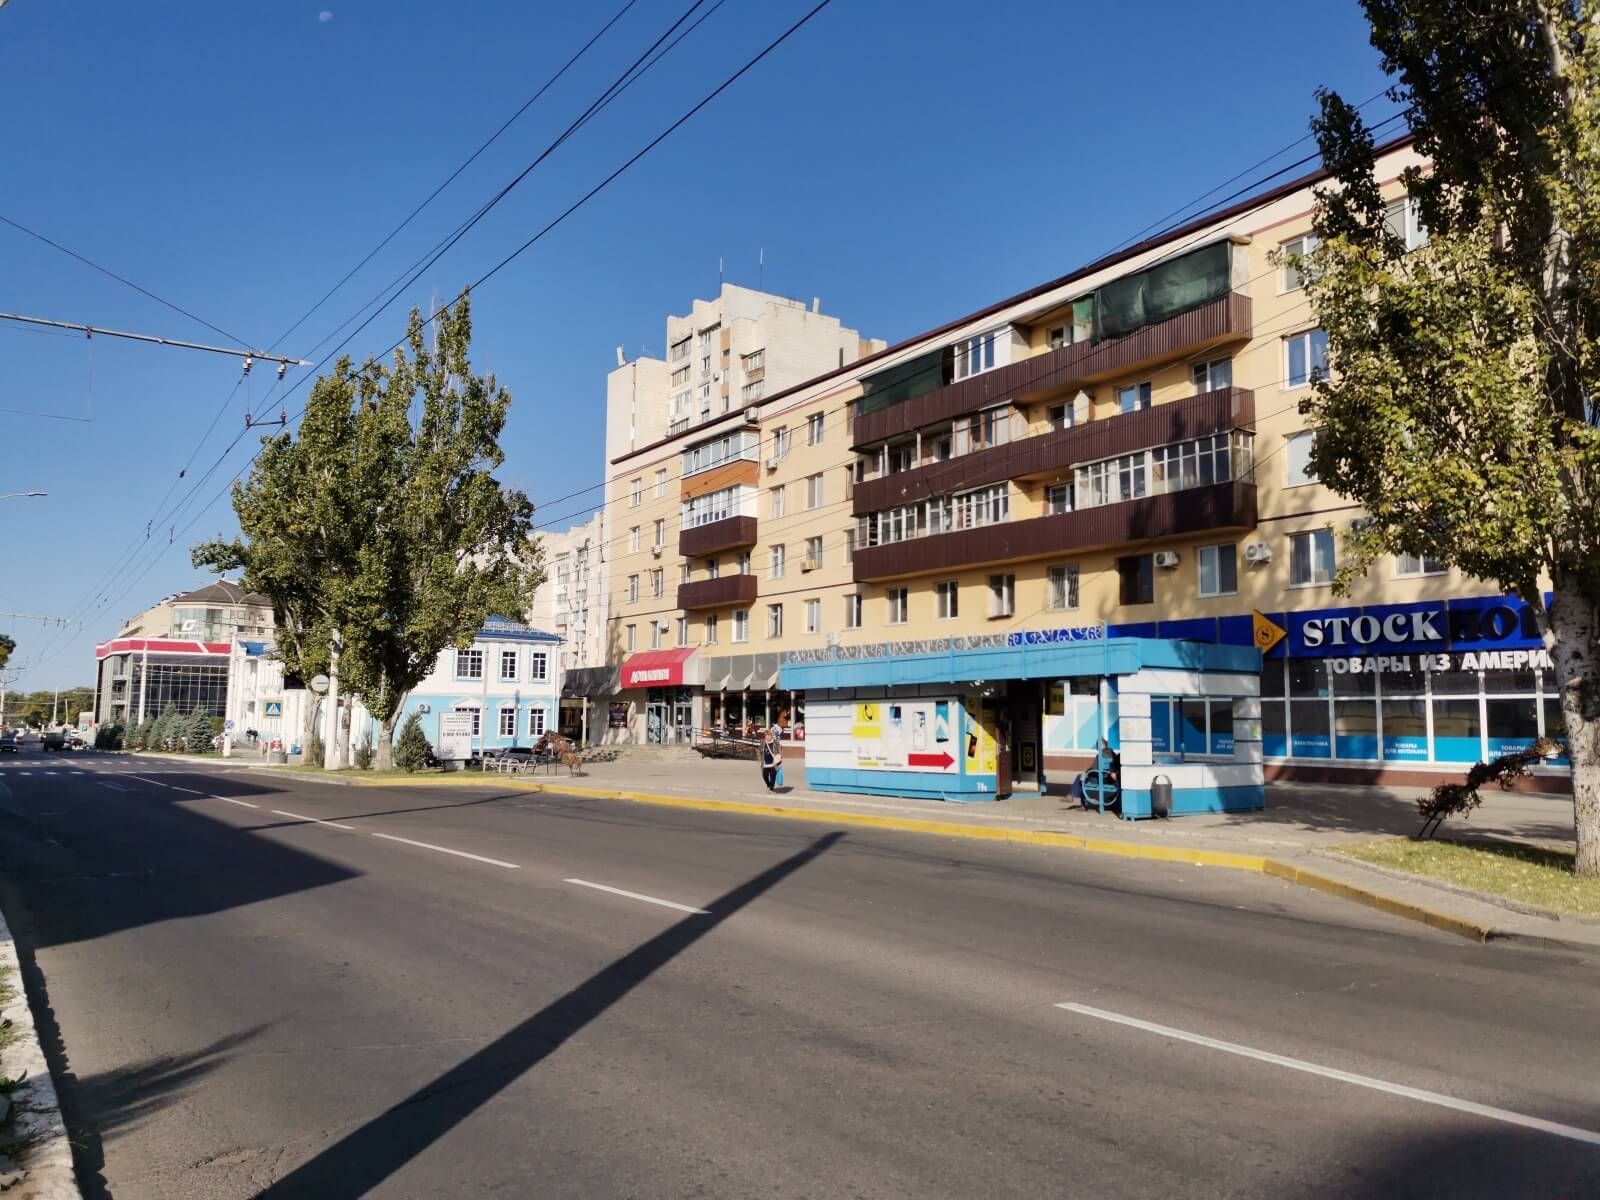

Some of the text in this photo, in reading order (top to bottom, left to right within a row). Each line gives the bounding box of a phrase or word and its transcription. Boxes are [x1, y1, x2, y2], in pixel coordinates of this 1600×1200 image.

[1302, 611, 1443, 647] STOCK
[1323, 655, 1411, 674] ТОВАРЫ
[1420, 653, 1451, 672] ИЗ
